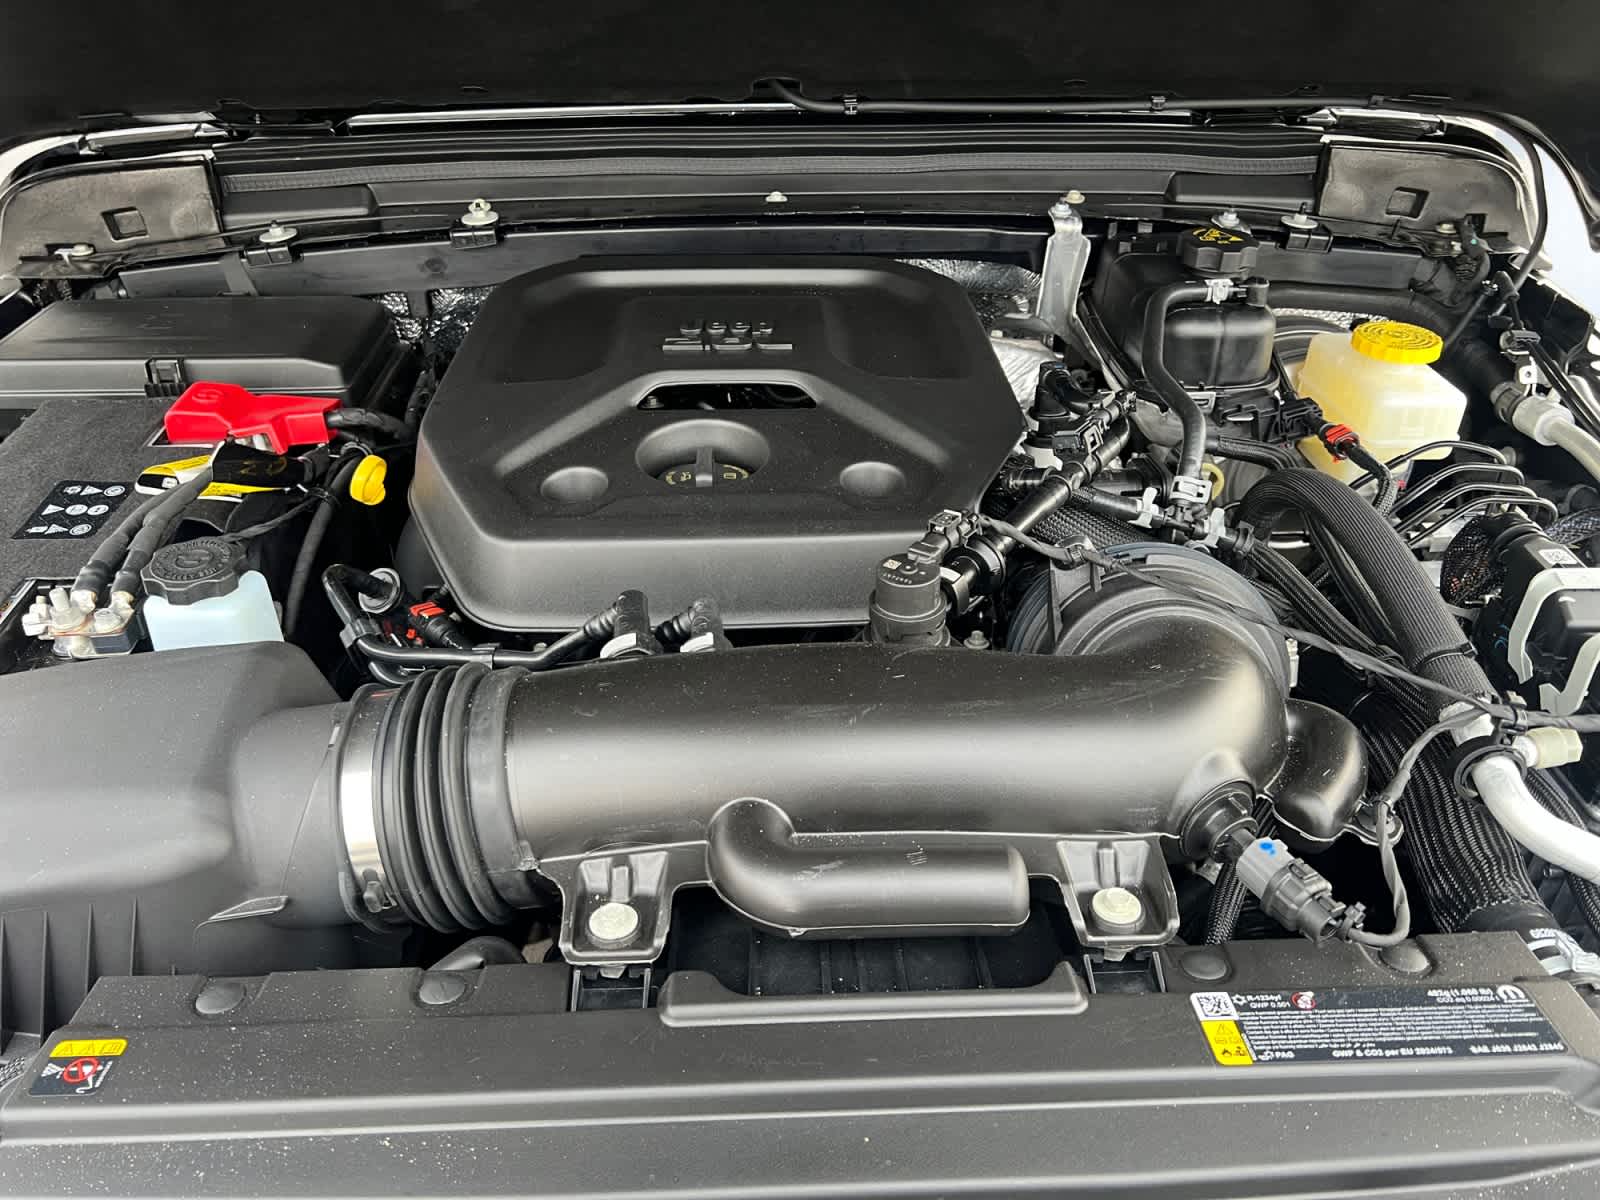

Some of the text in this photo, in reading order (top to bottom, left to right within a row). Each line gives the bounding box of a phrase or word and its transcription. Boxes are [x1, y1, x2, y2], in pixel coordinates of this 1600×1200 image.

[1275, 1051, 1295, 1059] PAG
[1332, 1049, 1354, 1058] GWP
[1364, 1049, 1384, 1057] CO2
